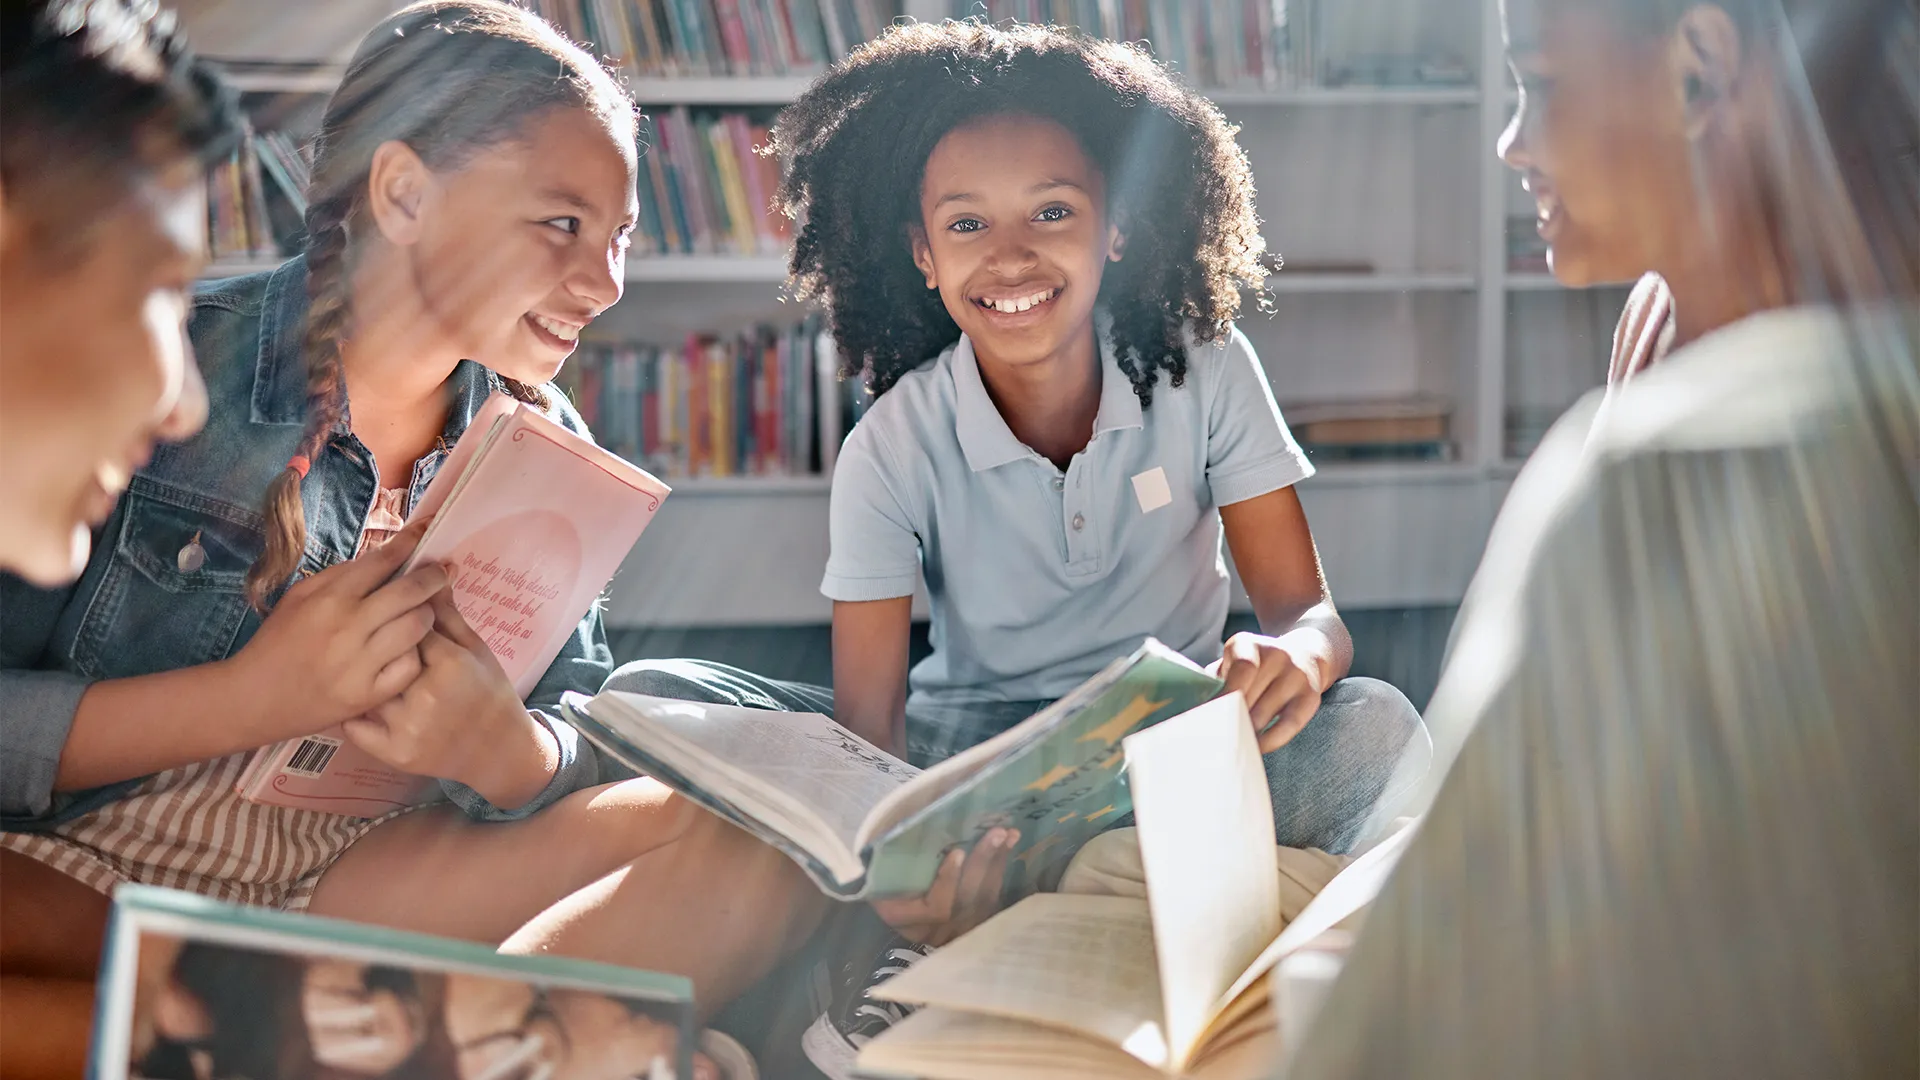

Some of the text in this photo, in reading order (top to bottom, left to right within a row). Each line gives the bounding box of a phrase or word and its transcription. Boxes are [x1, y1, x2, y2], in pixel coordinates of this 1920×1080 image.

[463, 552, 482, 569] One
[481, 556, 502, 580] day
[453, 571, 544, 618] to bake a cake but
[461, 600, 492, 623] don't
[475, 615, 498, 633] go
[497, 619, 525, 635] quite
[520, 629, 533, 639] as
